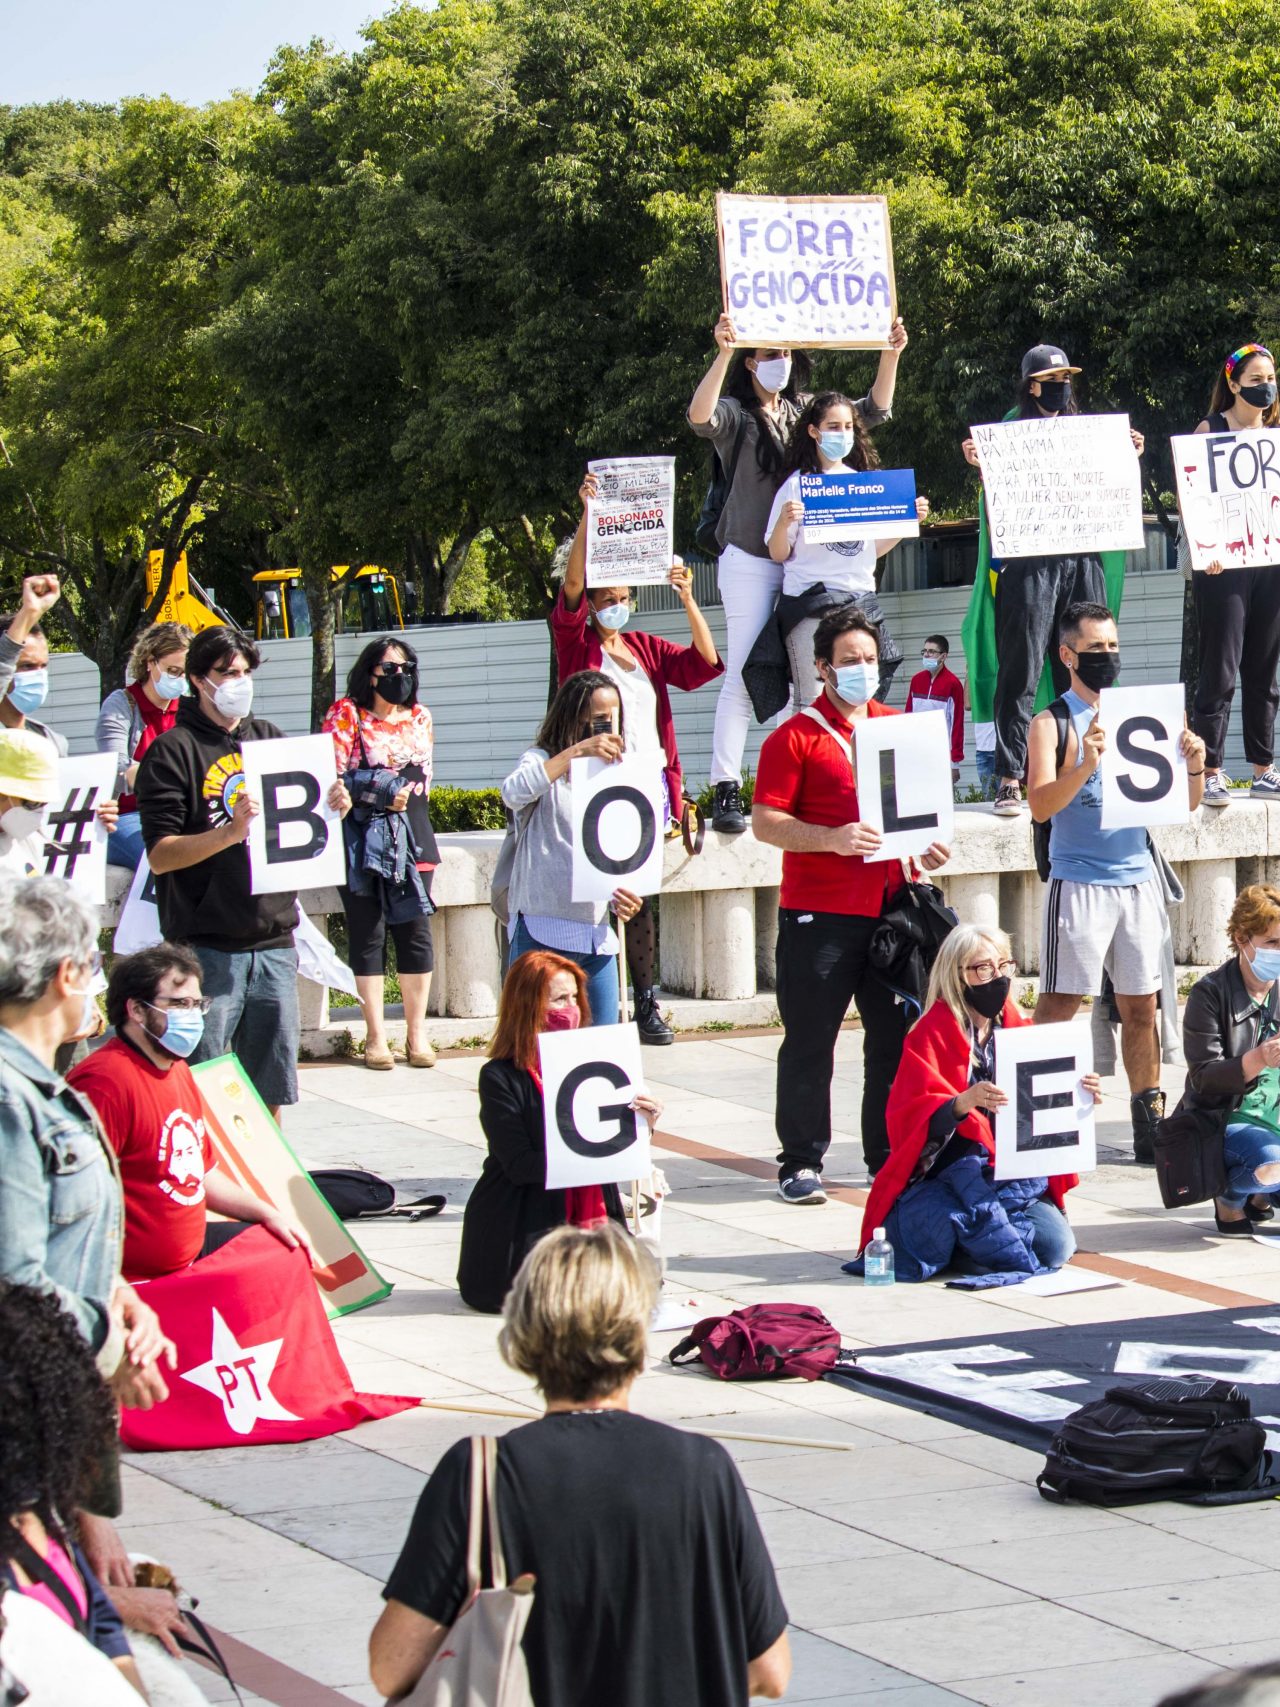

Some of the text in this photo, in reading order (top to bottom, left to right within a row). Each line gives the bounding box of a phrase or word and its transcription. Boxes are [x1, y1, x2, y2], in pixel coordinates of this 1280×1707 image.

[739, 218, 853, 257] FORA
[729, 270, 891, 309] GENOCIDA
[977, 428, 998, 444] NA
[981, 440, 1020, 459] PARA
[595, 482, 619, 492] MEIO
[801, 477, 822, 486] Rua
[802, 484, 885, 498] Marielle Franco
[1055, 490, 1091, 504] NENHUM
[1073, 471, 1106, 487] MORTE
[620, 493, 658, 503] MORTOS
[1015, 506, 1034, 522] FOR
[597, 508, 664, 526] BOLSONARO
[1114, 715, 1174, 803] S
[202, 763, 229, 800] THE
[879, 748, 939, 835] L
[43, 786, 99, 880] #
[260, 770, 329, 865] B
[581, 784, 656, 876] O
[554, 1060, 638, 1158] G
[1015, 1055, 1080, 1152] E
[214, 1356, 262, 1409] PT
